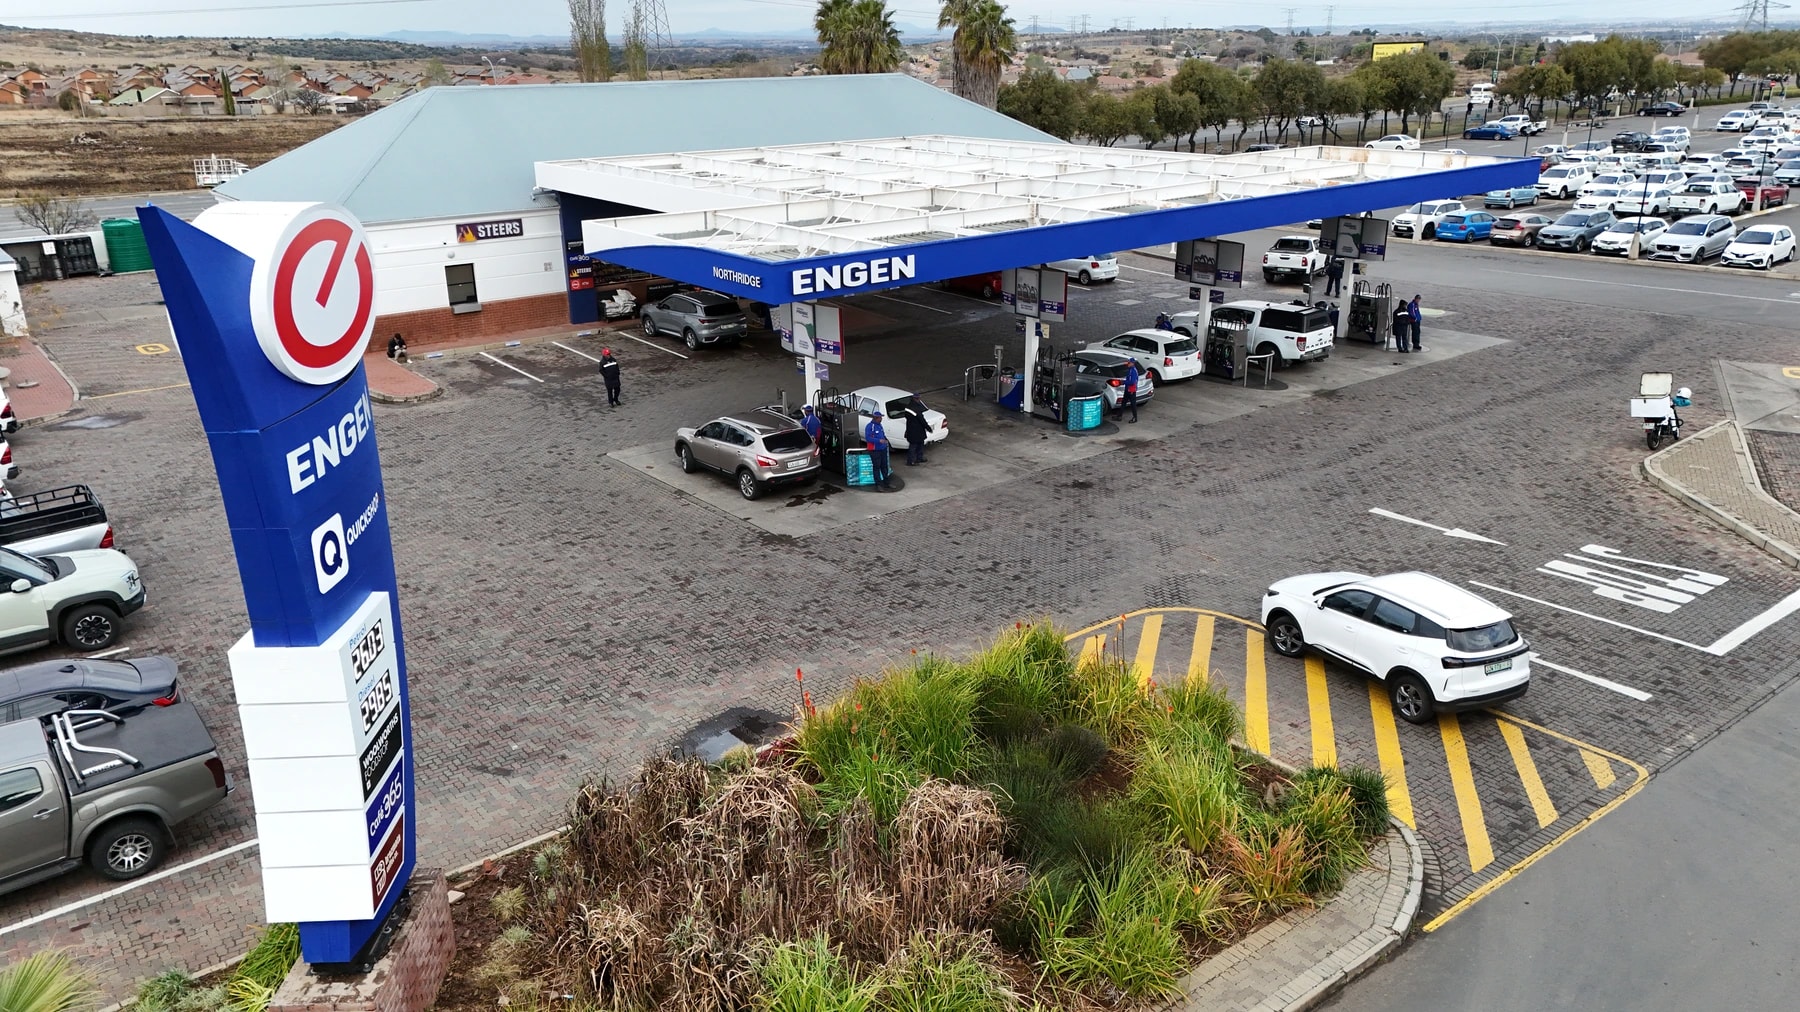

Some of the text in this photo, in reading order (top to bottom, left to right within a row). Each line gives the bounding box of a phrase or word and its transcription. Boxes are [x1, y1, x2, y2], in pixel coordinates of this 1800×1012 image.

[477, 221, 521, 238] STEERS
[712, 266, 761, 288] NORTHRIDGE
[792, 254, 916, 296] ENGEN
[285, 385, 374, 495] ENGEN
[346, 492, 379, 546] QUICKSHOP
[1535, 543, 1730, 614] STOP
[350, 622, 367, 648] Petrol
[358, 674, 375, 702] Diesel
[362, 712, 399, 769] WOOLWORTHS
[364, 740, 389, 781] FOODSTOP
